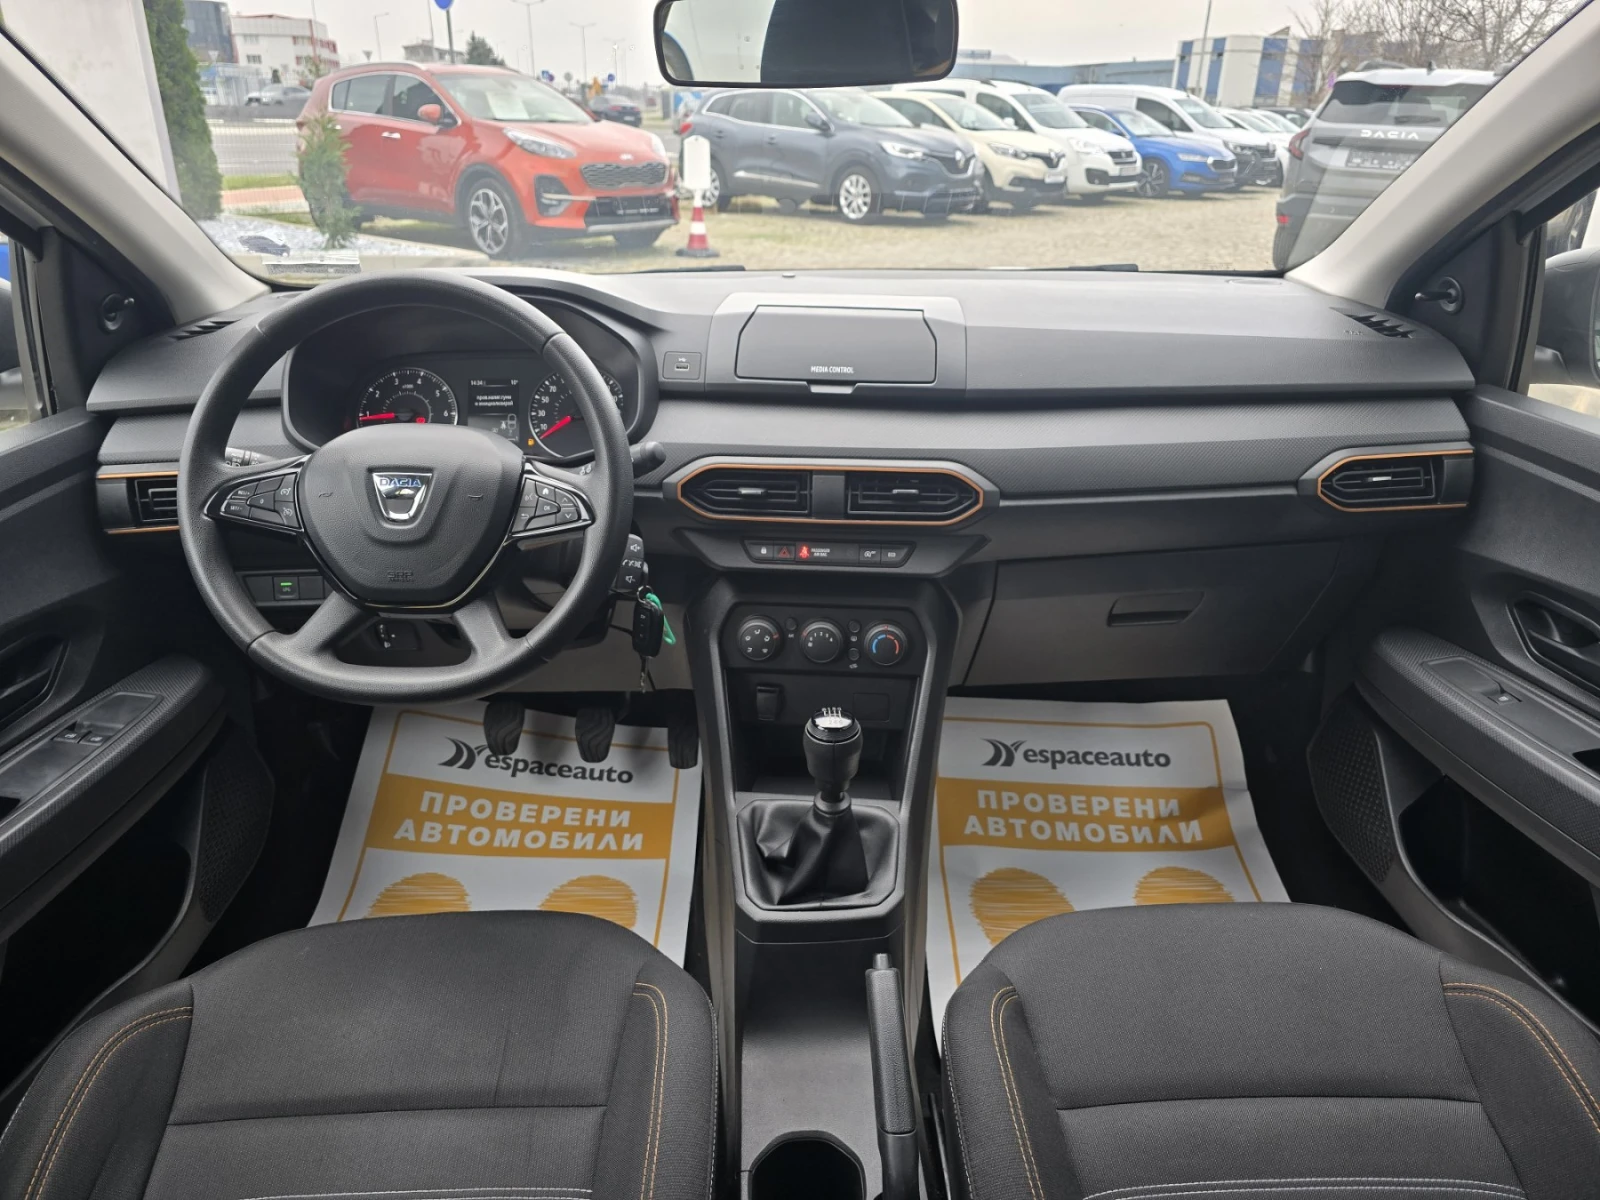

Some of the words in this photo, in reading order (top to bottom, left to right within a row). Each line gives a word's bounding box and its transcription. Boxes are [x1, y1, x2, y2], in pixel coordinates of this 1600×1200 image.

[1360, 129, 1419, 140] DACIA
[810, 365, 828, 373] MEDIA
[829, 366, 854, 374] CONTROL
[549, 385, 557, 393] 70
[541, 396, 550, 404] 50
[540, 423, 548, 431] 10
[379, 477, 422, 488] DACIA
[1023, 748, 1172, 770] espaceauto
[484, 753, 634, 784] espaceauto
[419, 790, 631, 828] ПРОВЕРЕНИ
[977, 789, 1180, 819] ПРОВЕРЕНИ
[393, 818, 643, 851] АВТОМОБИЛИ
[963, 815, 1203, 844] АВТОМОБИЛИ
